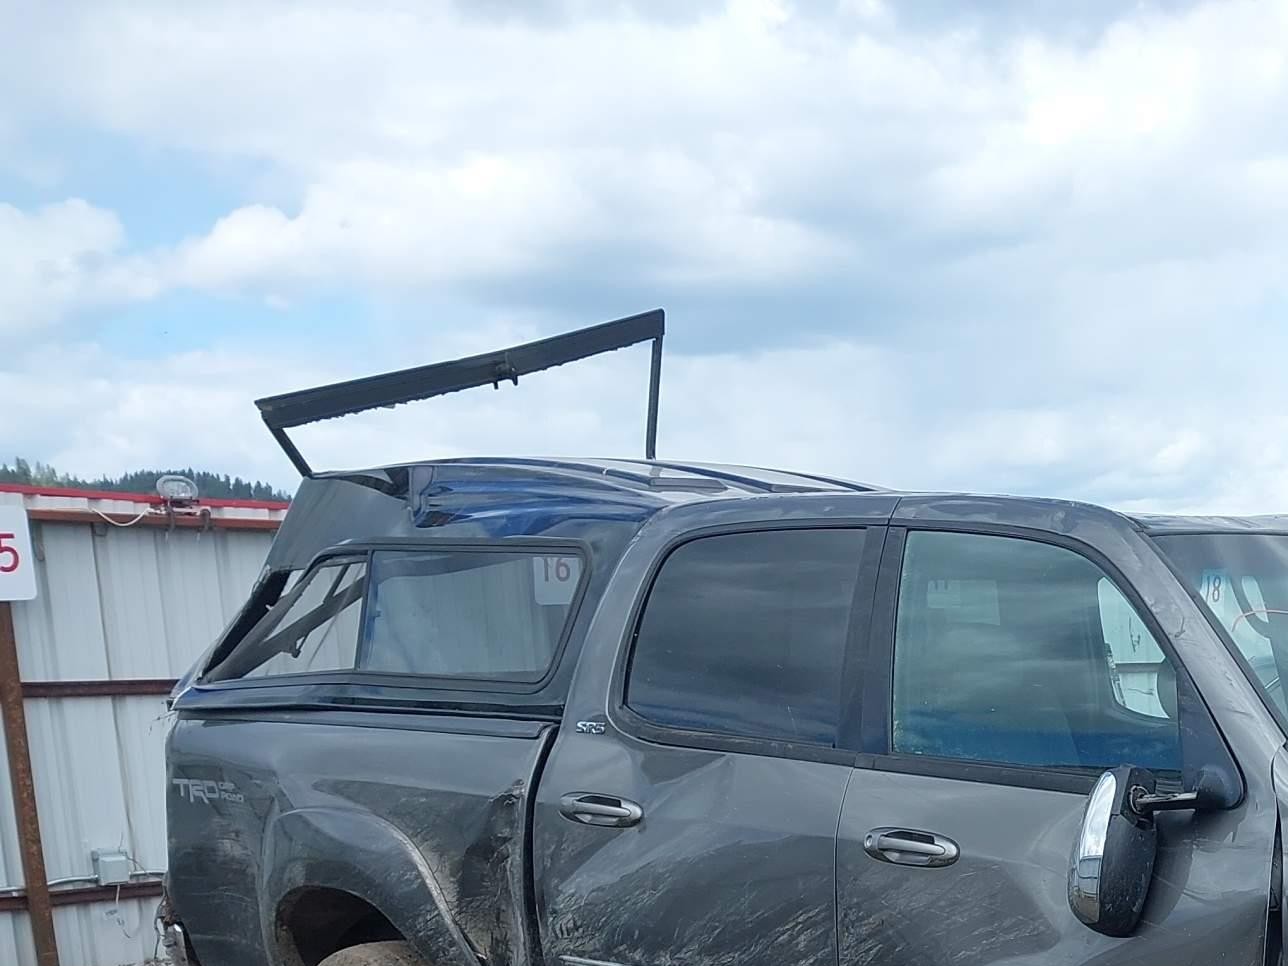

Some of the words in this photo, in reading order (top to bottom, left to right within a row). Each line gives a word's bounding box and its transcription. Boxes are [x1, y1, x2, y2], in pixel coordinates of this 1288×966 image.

[543, 558, 571, 582] 16
[576, 721, 606, 734] SR5
[172, 778, 220, 804] TRD
